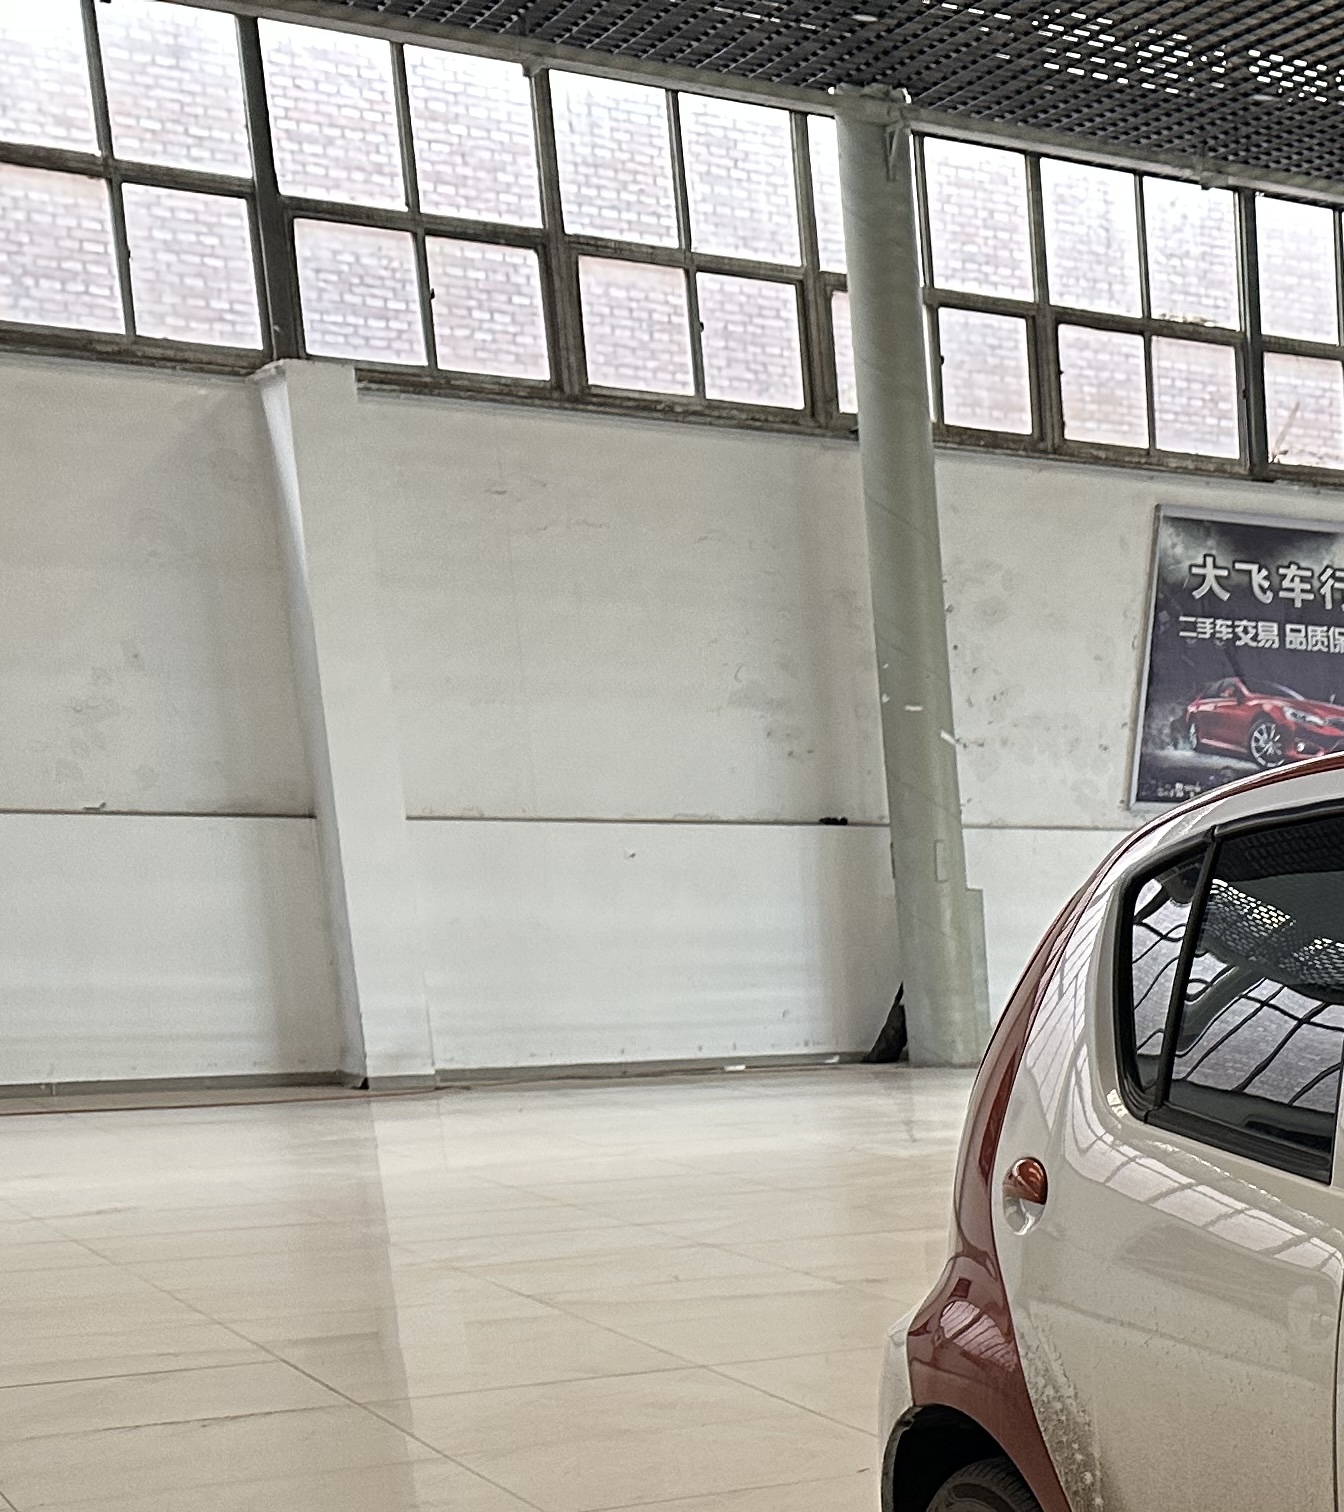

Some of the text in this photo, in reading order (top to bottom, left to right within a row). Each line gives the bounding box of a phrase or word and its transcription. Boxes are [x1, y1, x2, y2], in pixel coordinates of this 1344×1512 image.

[1178, 615, 1280, 649] 二手车交易
